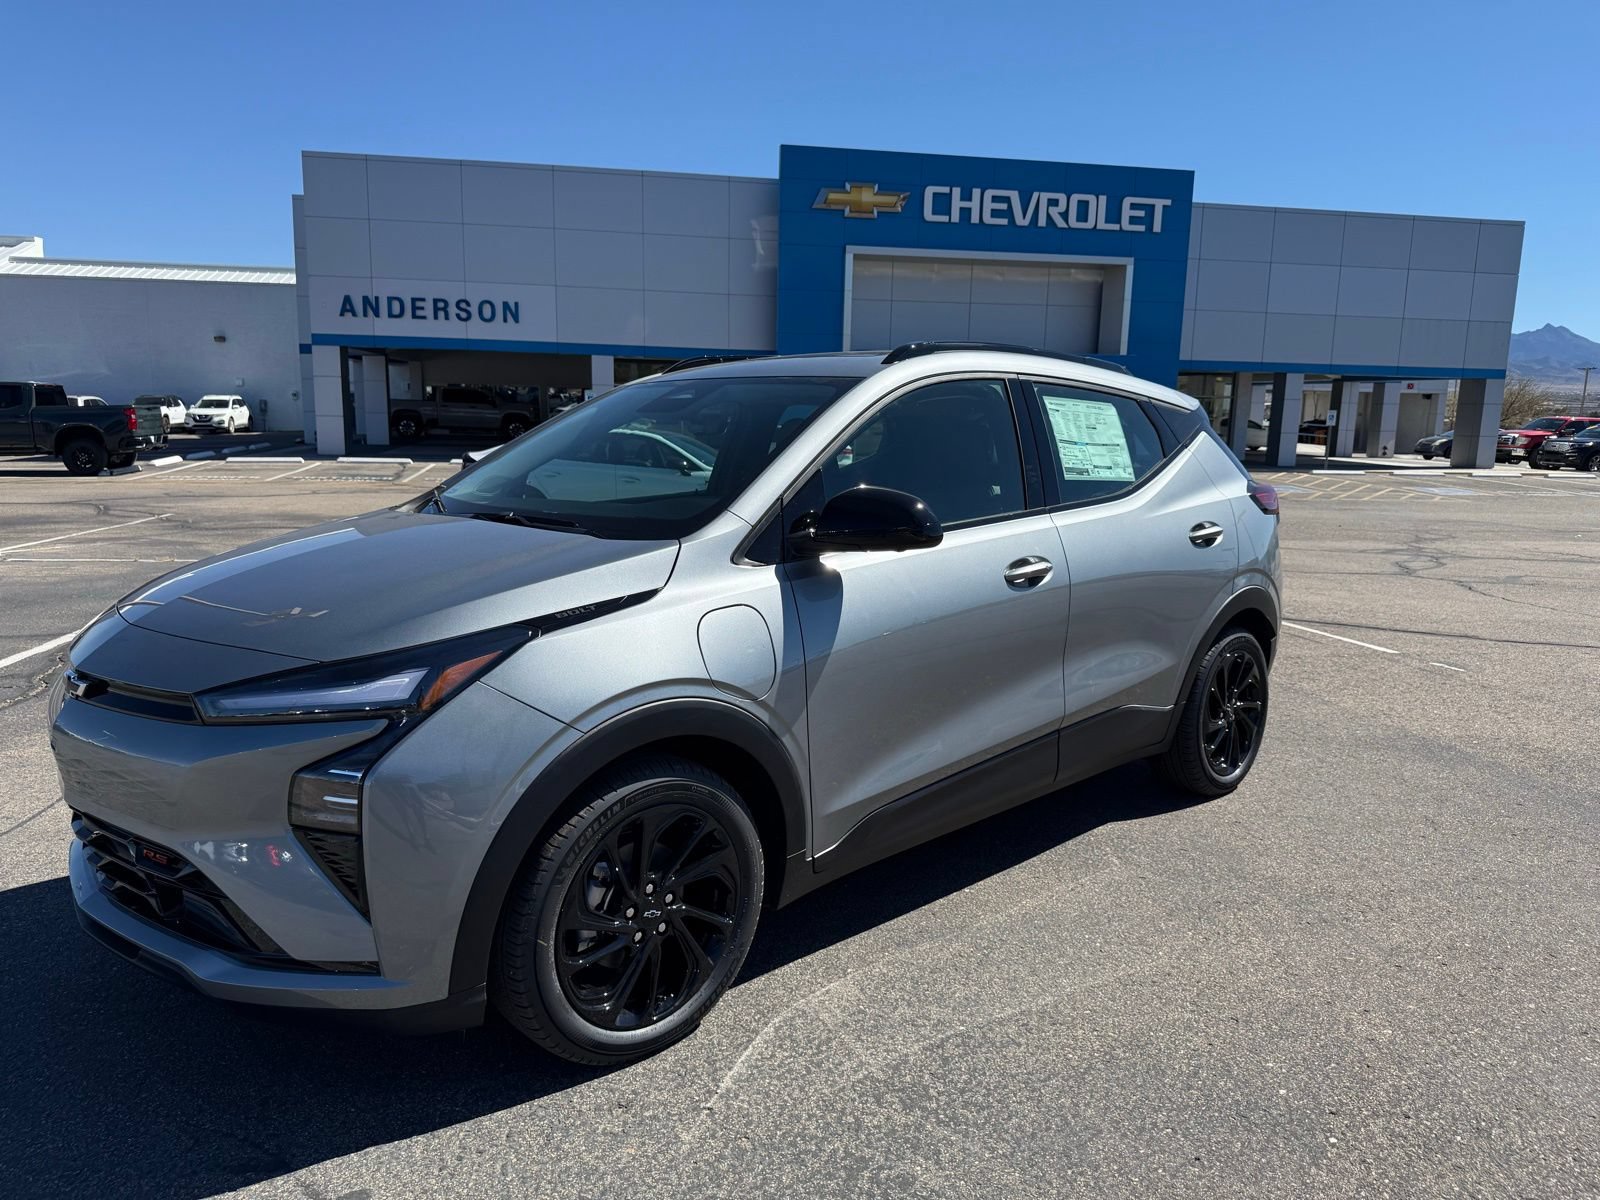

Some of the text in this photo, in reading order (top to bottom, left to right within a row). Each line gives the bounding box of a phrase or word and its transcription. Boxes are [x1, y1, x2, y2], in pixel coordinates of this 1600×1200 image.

[923, 185, 1172, 233] CHEVROLET
[339, 294, 520, 324] ANDERSON
[554, 604, 598, 619] BOLT
[143, 848, 168, 865] RS
